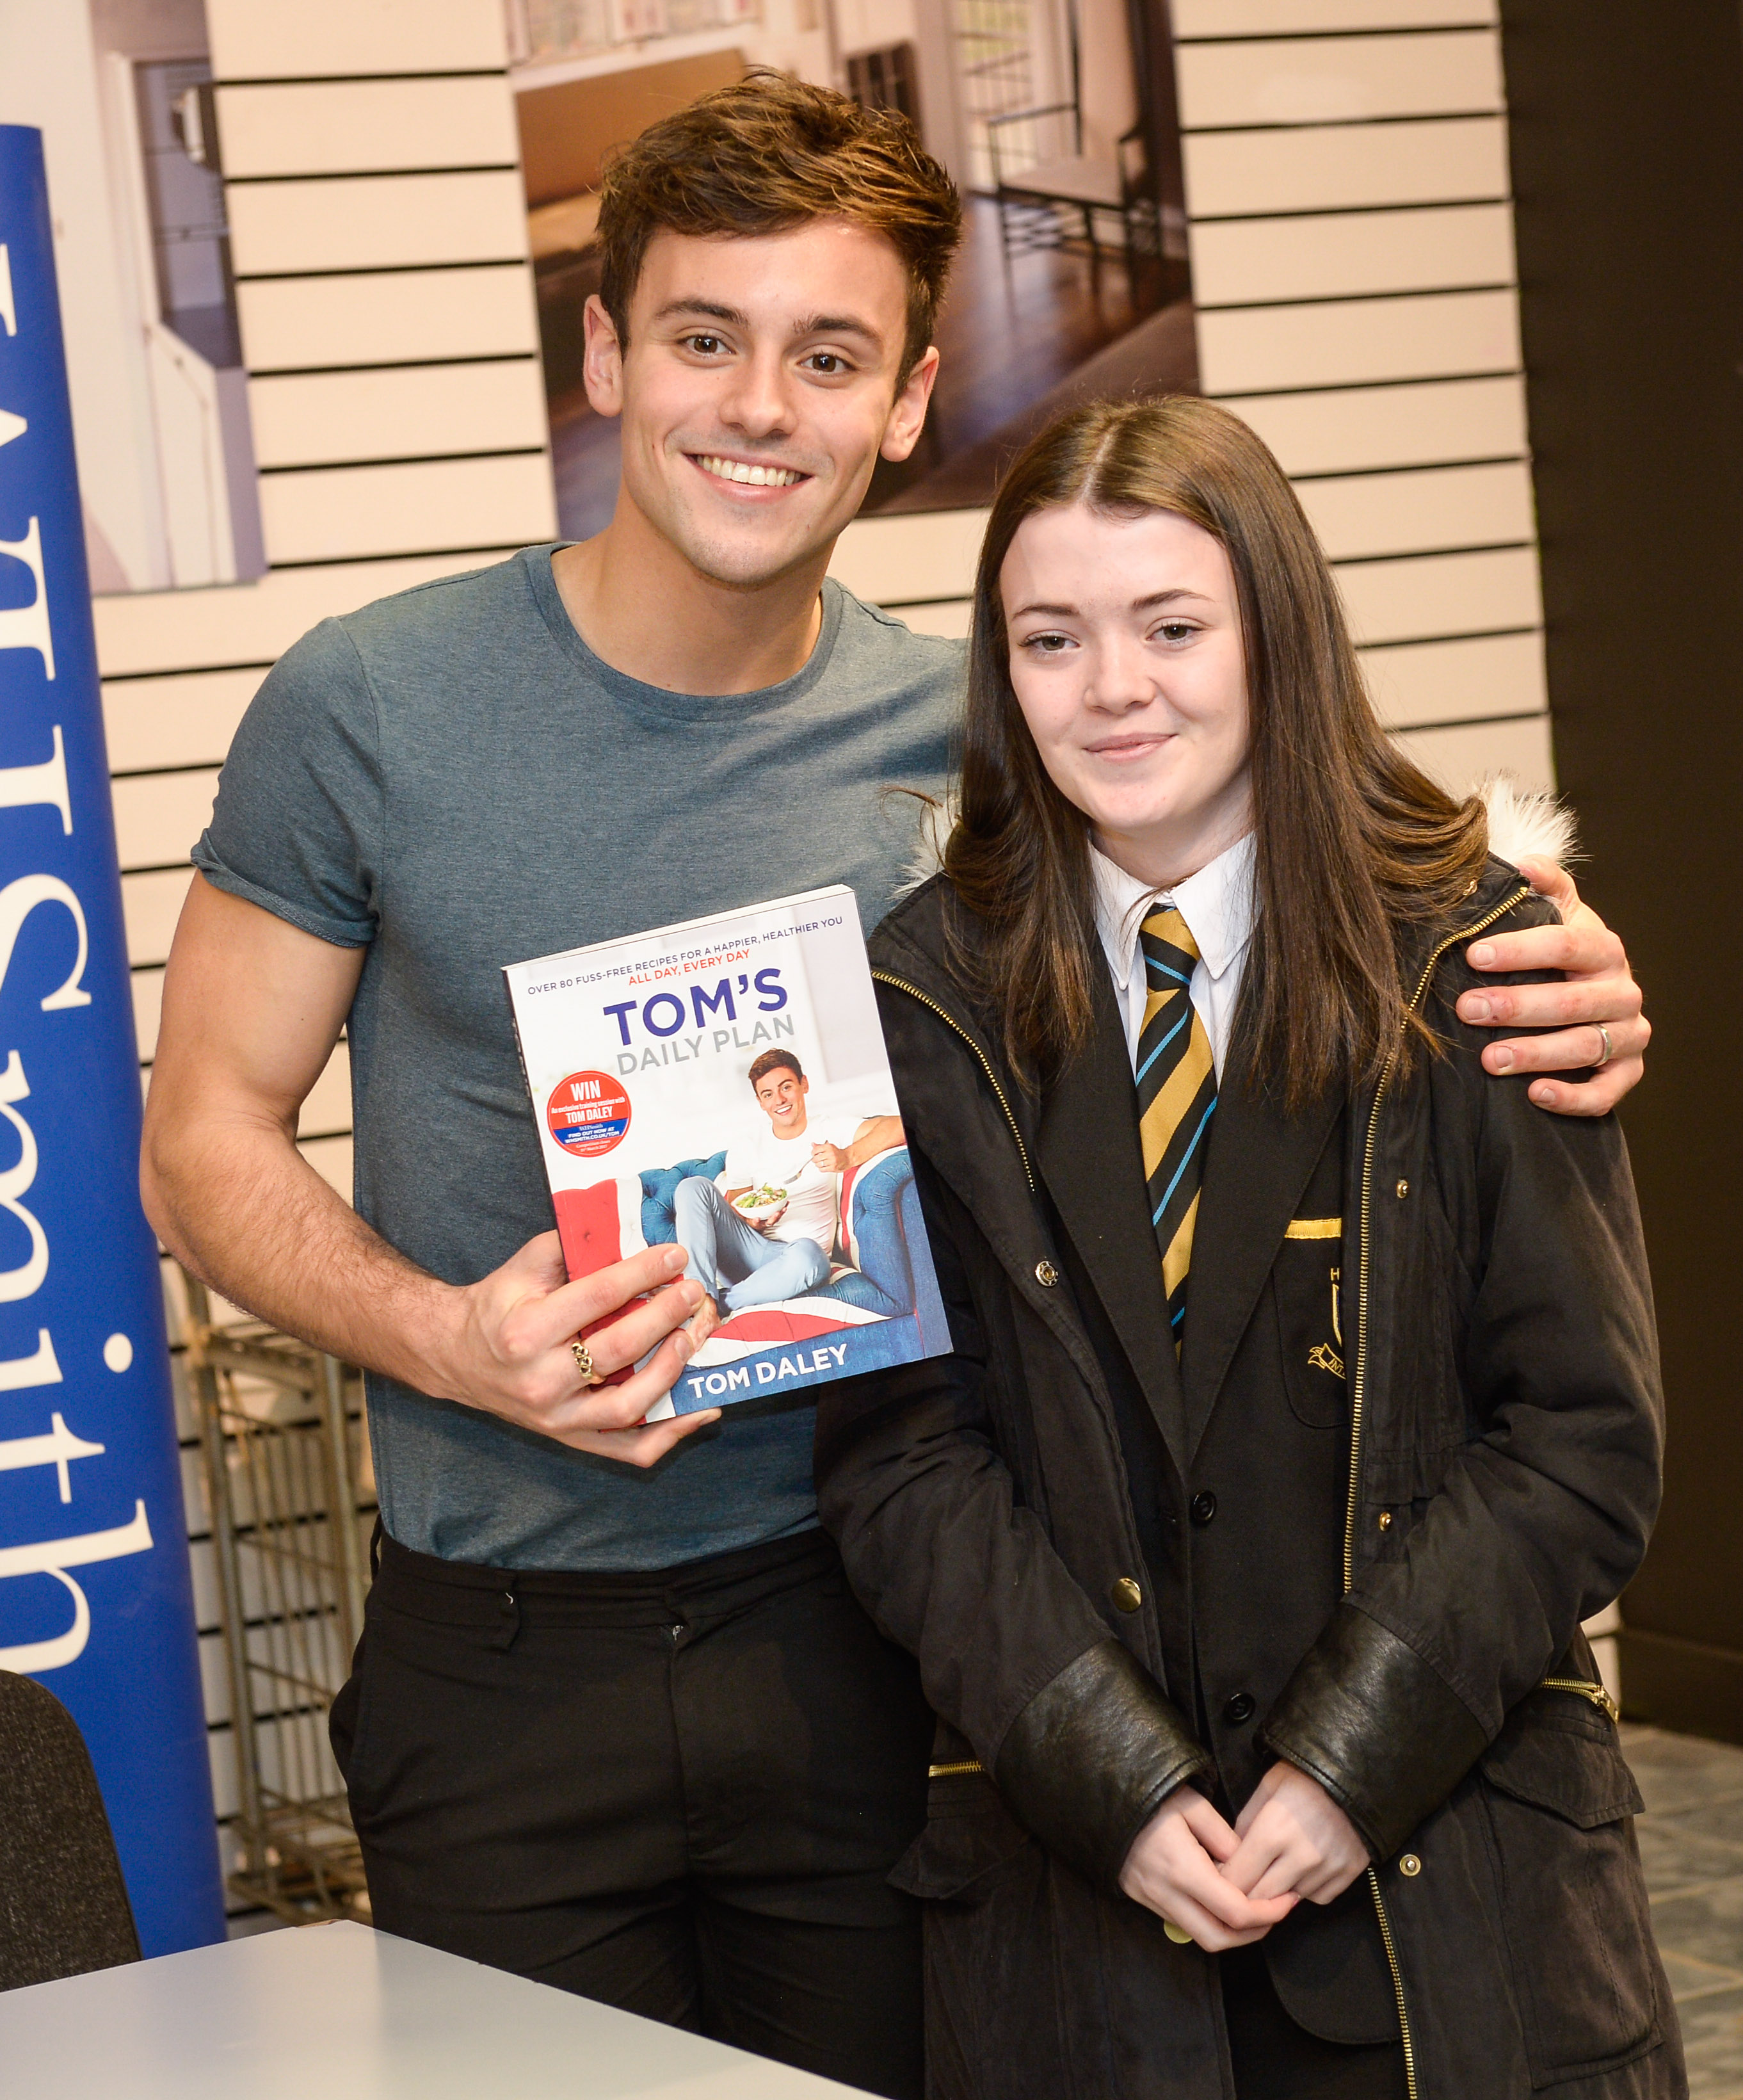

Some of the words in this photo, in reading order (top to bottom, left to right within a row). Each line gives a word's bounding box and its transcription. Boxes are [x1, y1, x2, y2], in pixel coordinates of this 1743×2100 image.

[528, 982, 557, 994] OVER
[560, 979, 573, 989] 80
[576, 965, 633, 985] FUSS-FREE
[636, 955, 678, 971] RECIPES
[680, 949, 702, 961] FOR
[714, 936, 761, 953] HAPPIER,
[763, 922, 819, 941] HEALTHIER
[821, 916, 843, 928] YOU
[629, 974, 652, 985] ALL
[655, 965, 681, 980] DAY,
[684, 955, 723, 973] EVERY
[727, 949, 750, 962] DAY
[603, 968, 788, 1046] TOM'S
[617, 1035, 703, 1075] DAILY
[713, 1014, 794, 1053] PLAN
[570, 1079, 601, 1101] WIN
[565, 1110, 585, 1124] TOM
[586, 1106, 613, 1121] DALEY
[687, 1366, 751, 1398] TOM
[755, 1343, 847, 1384] DALEY
[1328, 1358, 1345, 1376] INT
